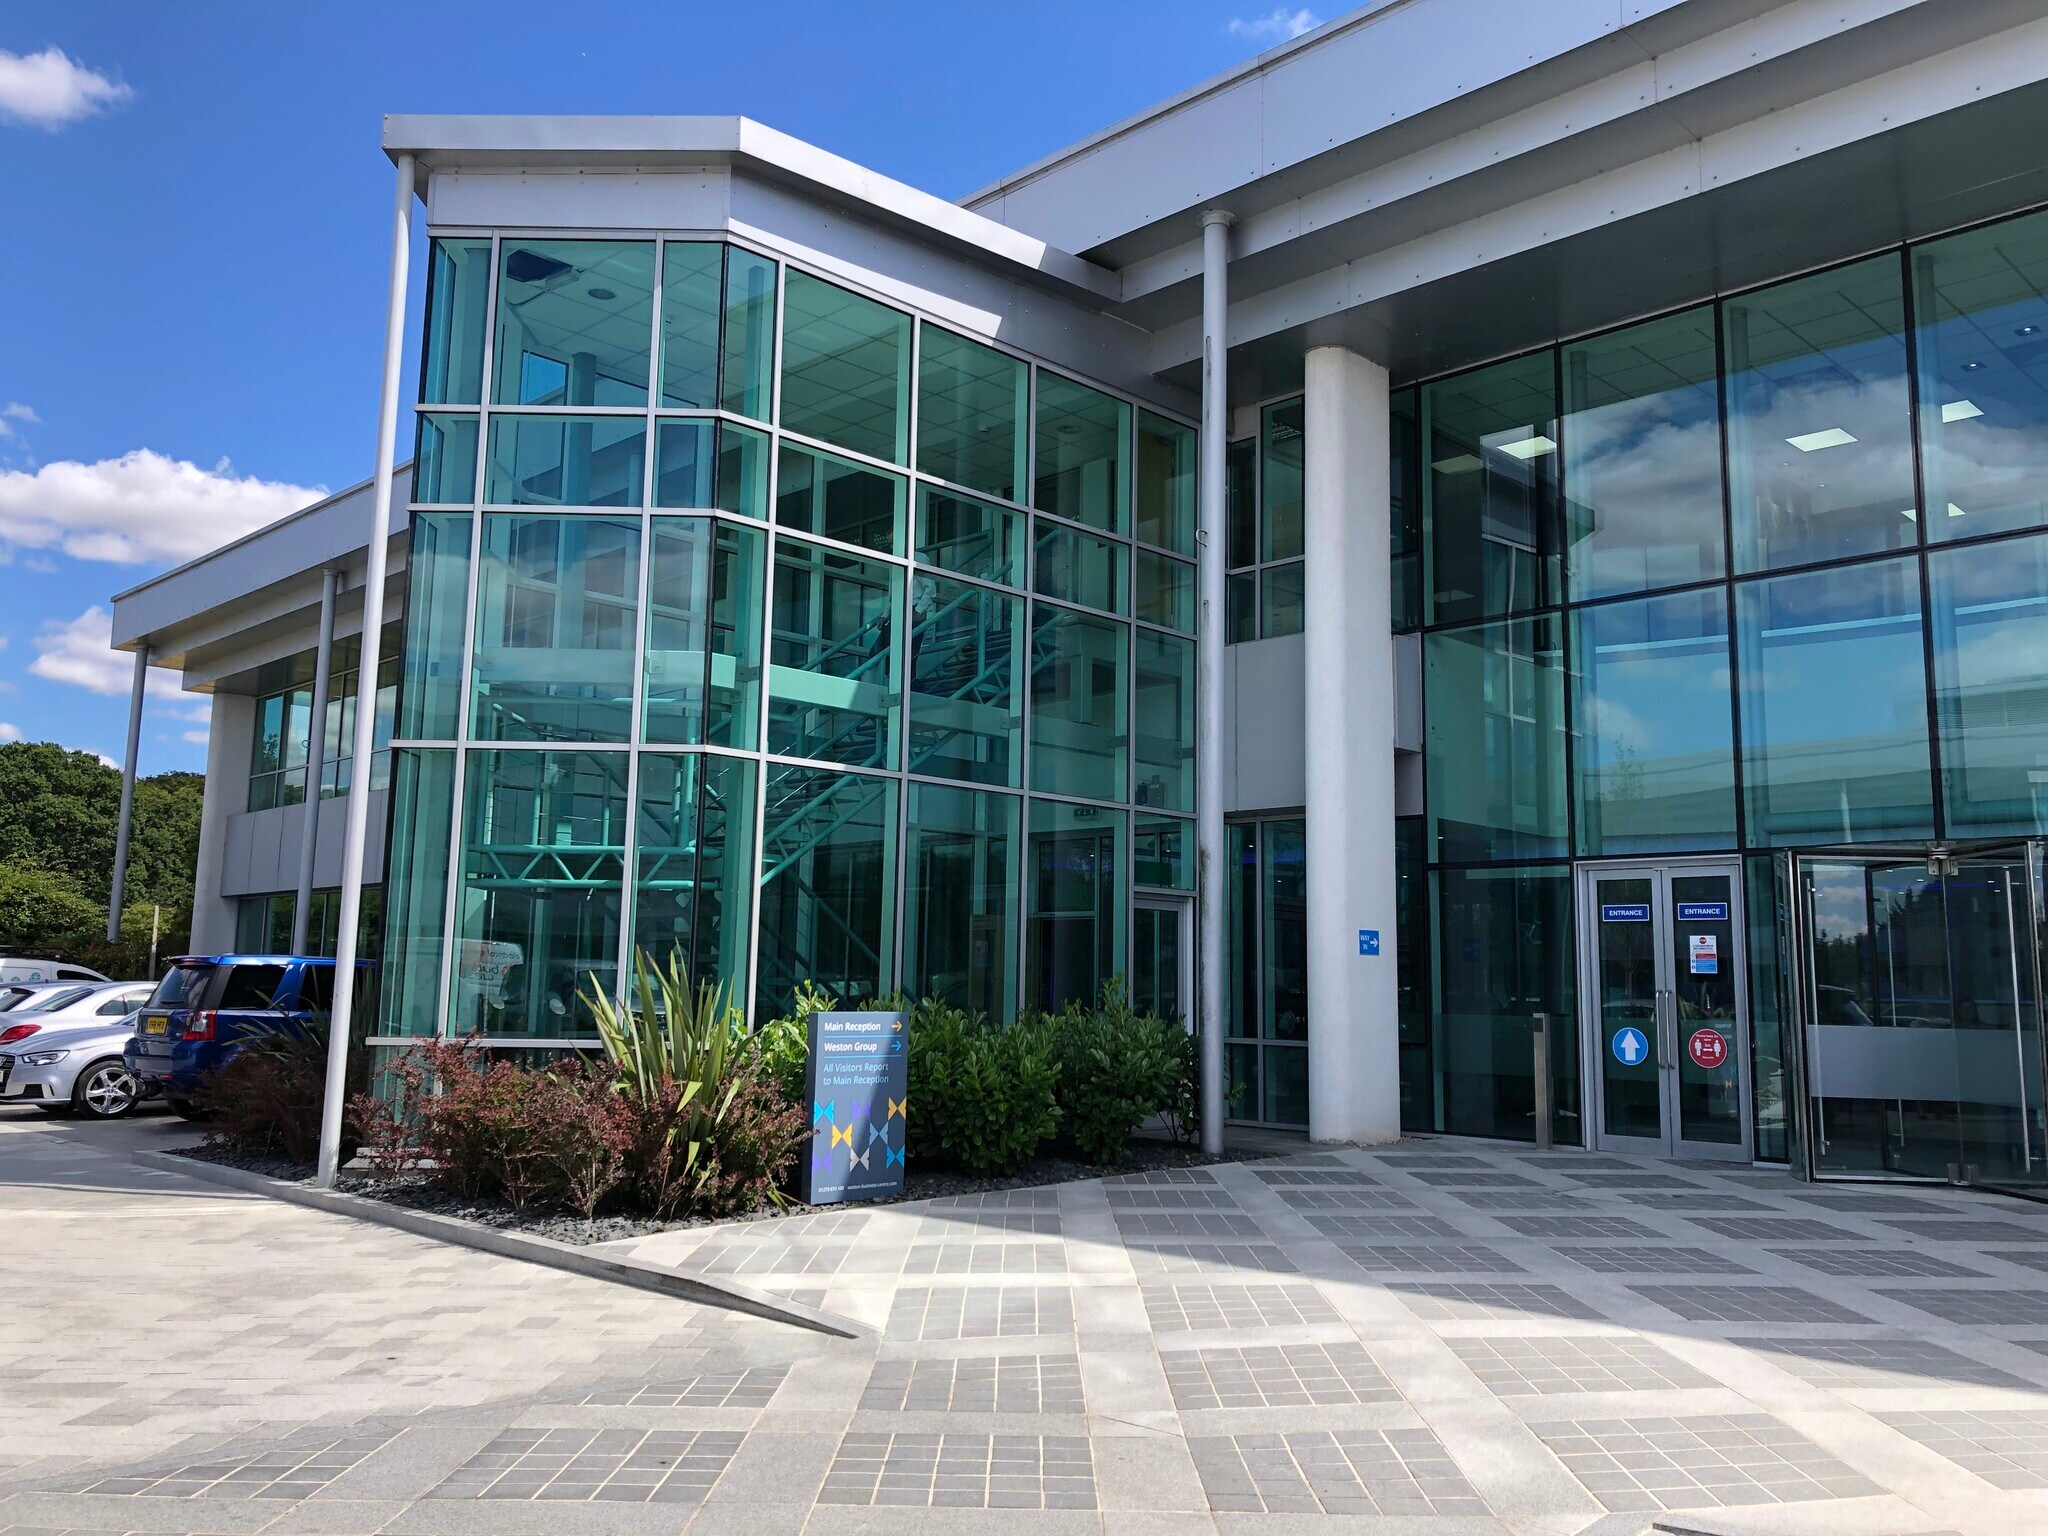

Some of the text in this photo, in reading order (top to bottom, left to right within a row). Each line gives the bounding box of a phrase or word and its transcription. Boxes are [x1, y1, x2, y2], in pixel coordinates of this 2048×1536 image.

[1609, 909, 1643, 917] ENTRANCE
[824, 1021, 881, 1033] Main Reception
[824, 1042, 877, 1053] Weston Group
[823, 1063, 889, 1073] All Visitors Report
[823, 1075, 889, 1085] to Main Reception
